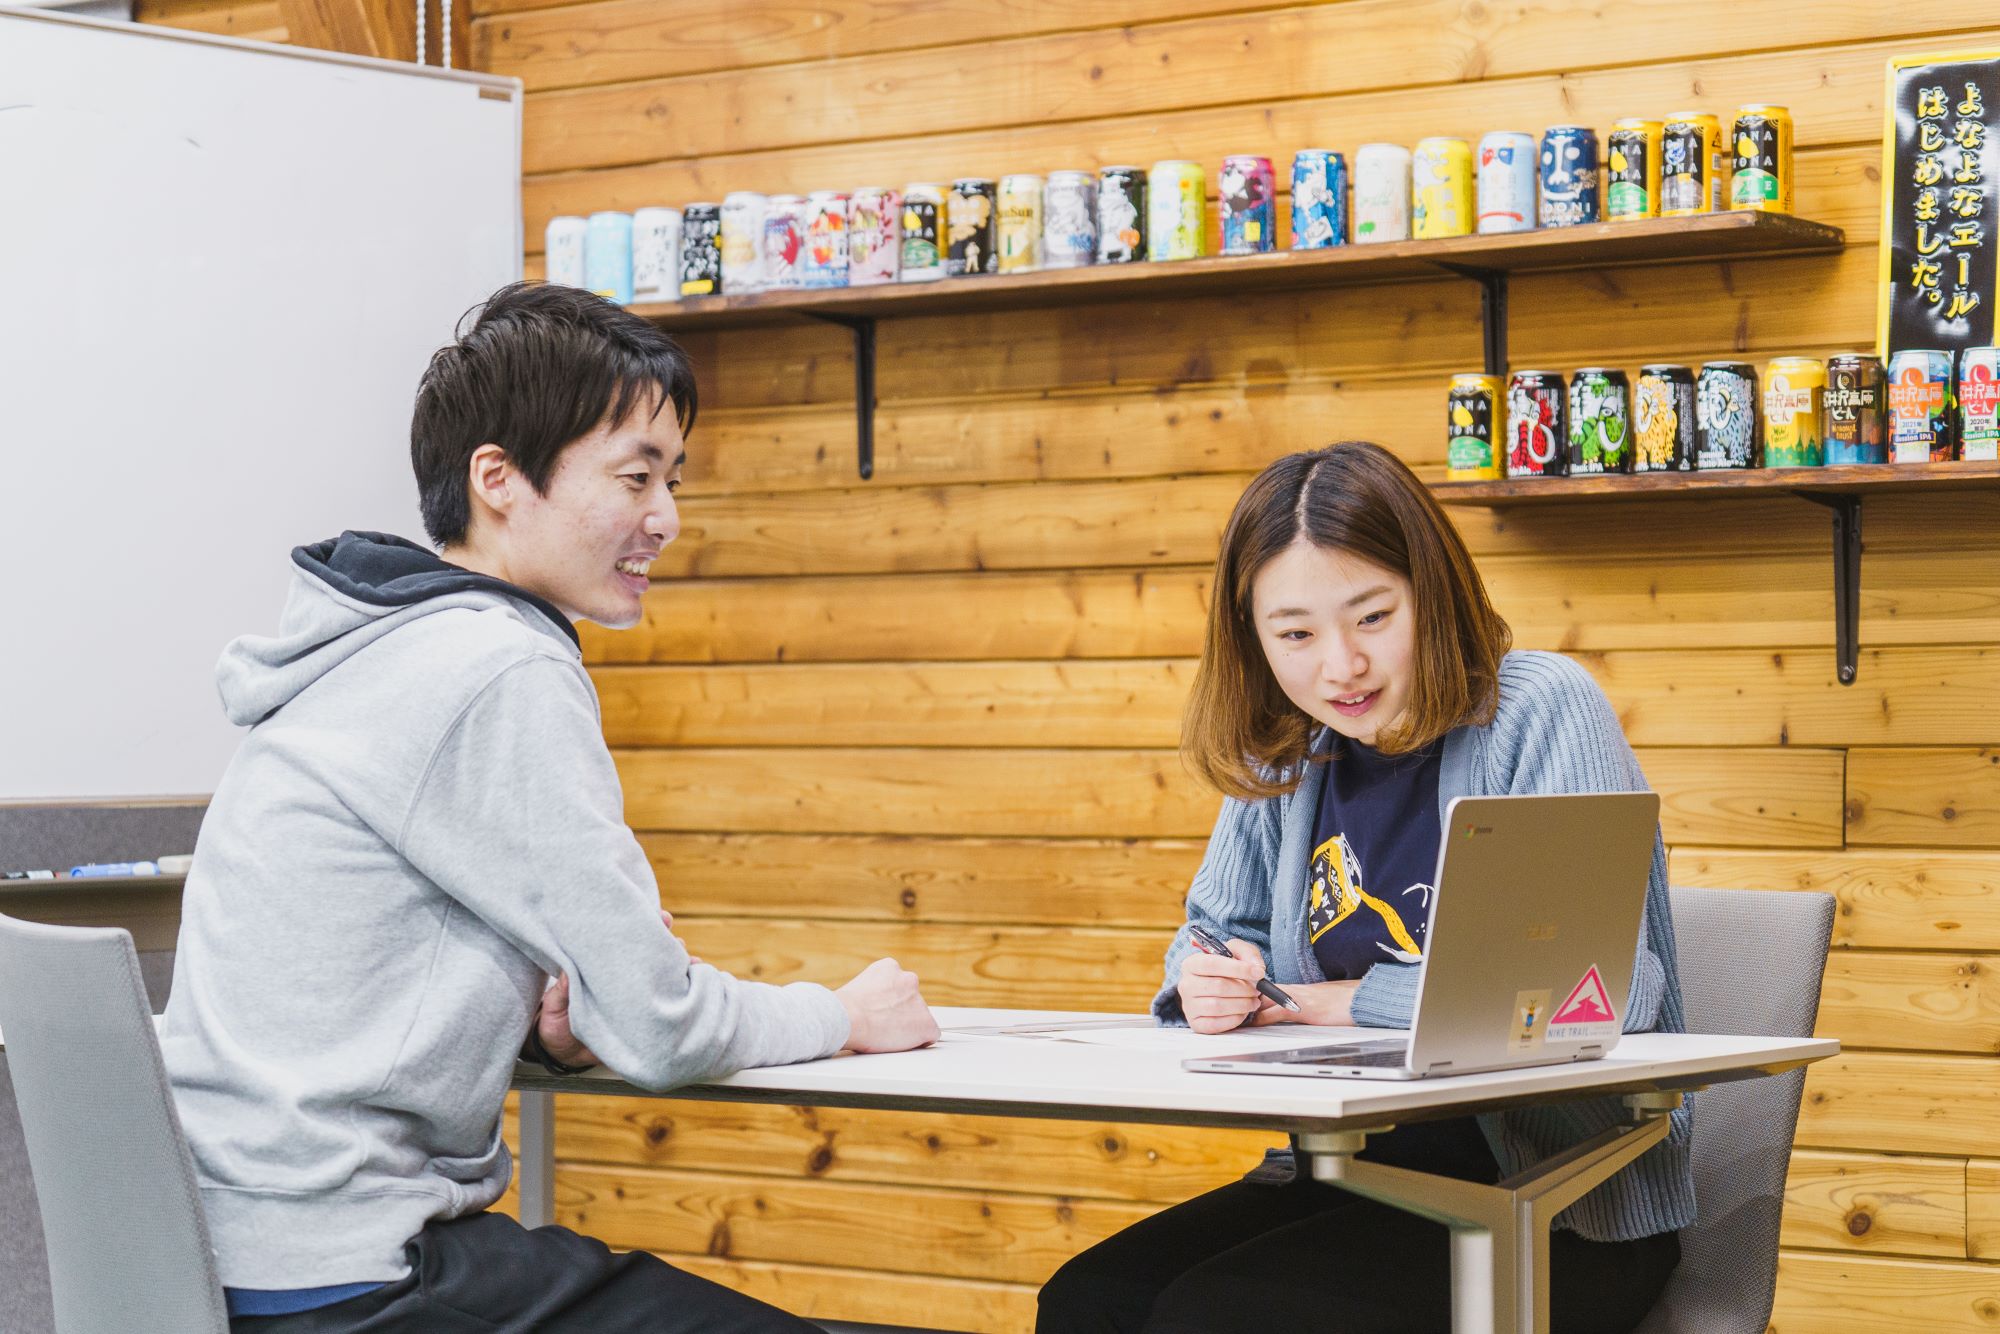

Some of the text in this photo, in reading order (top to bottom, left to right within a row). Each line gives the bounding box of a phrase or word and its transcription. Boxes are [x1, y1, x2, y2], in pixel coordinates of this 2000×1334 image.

[1911, 88, 1947, 304] はじめました。
[1948, 82, 1985, 320] よなよなエール
[1920, 432, 1932, 441] IPA
[1987, 430, 1999, 438] IPA
[1568, 1027, 1589, 1038] TRAIL
